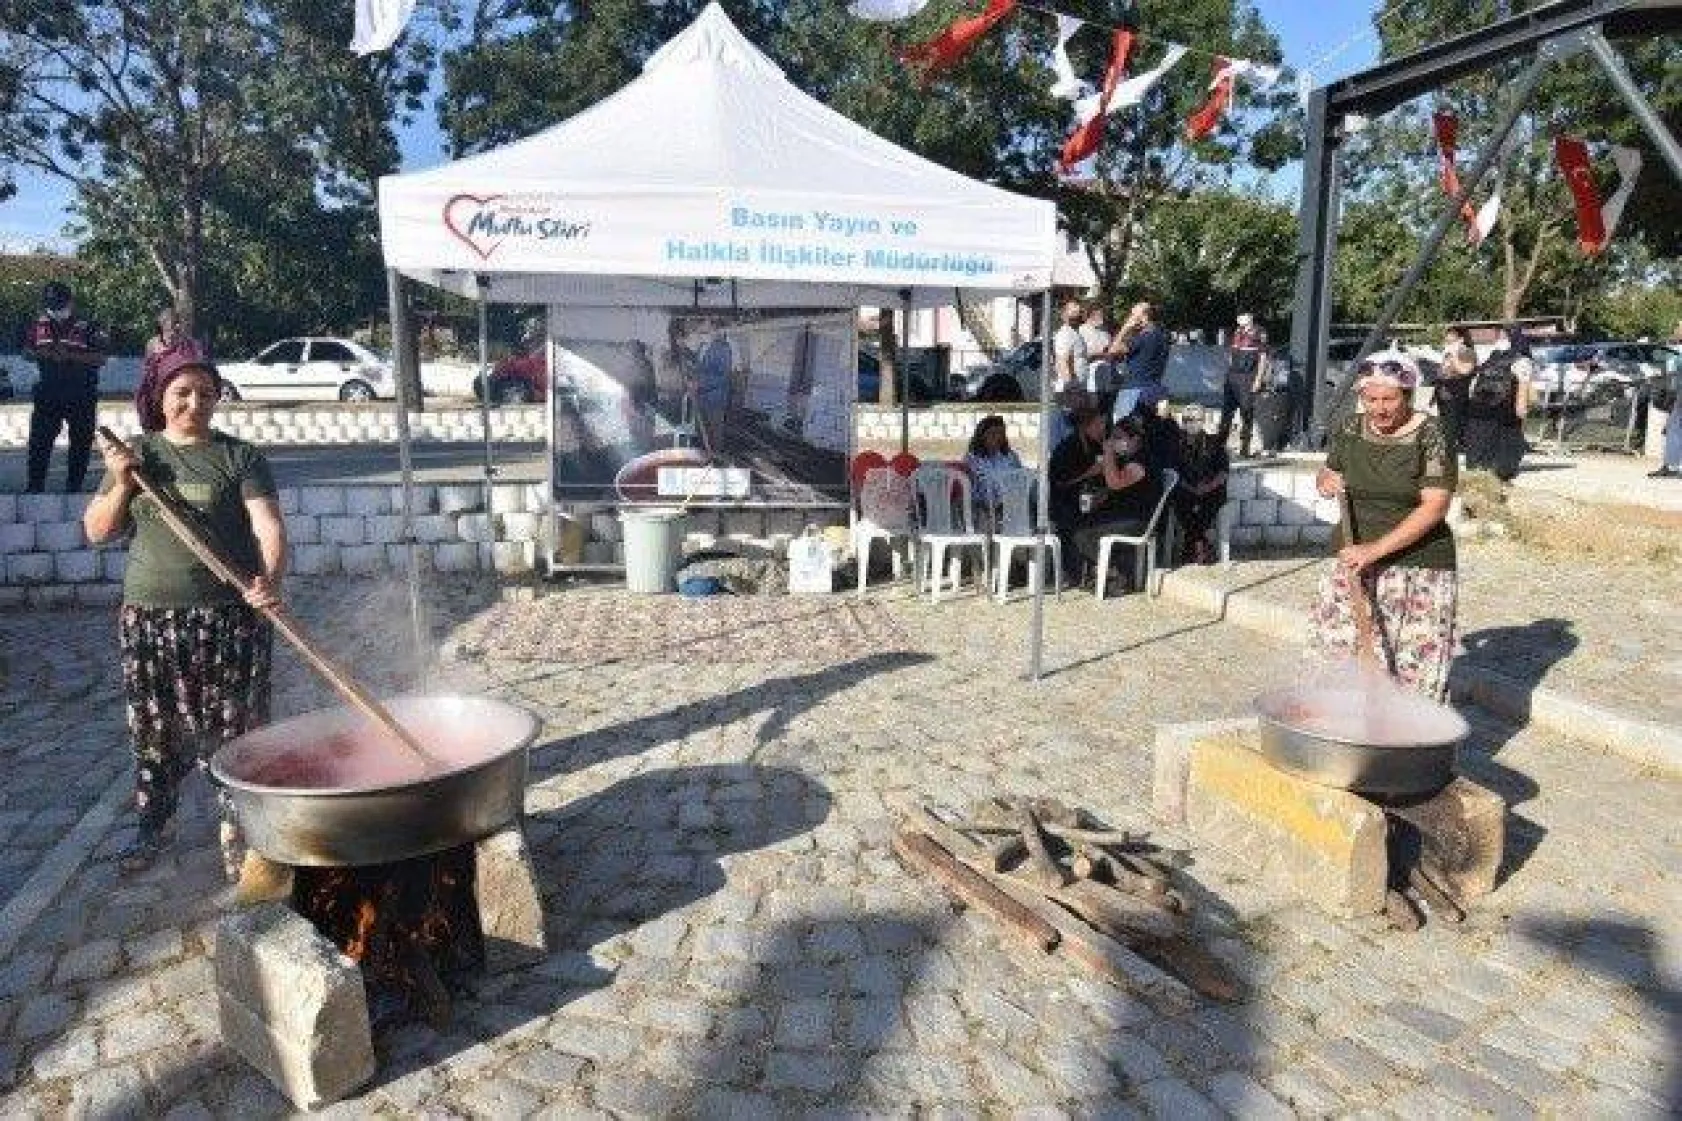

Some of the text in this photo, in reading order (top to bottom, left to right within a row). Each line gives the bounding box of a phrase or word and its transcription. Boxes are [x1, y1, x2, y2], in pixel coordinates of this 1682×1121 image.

[730, 206, 918, 236] Basın Yayın ve
[665, 239, 995, 275] Halkla İlişkiler Müdürlüğü
